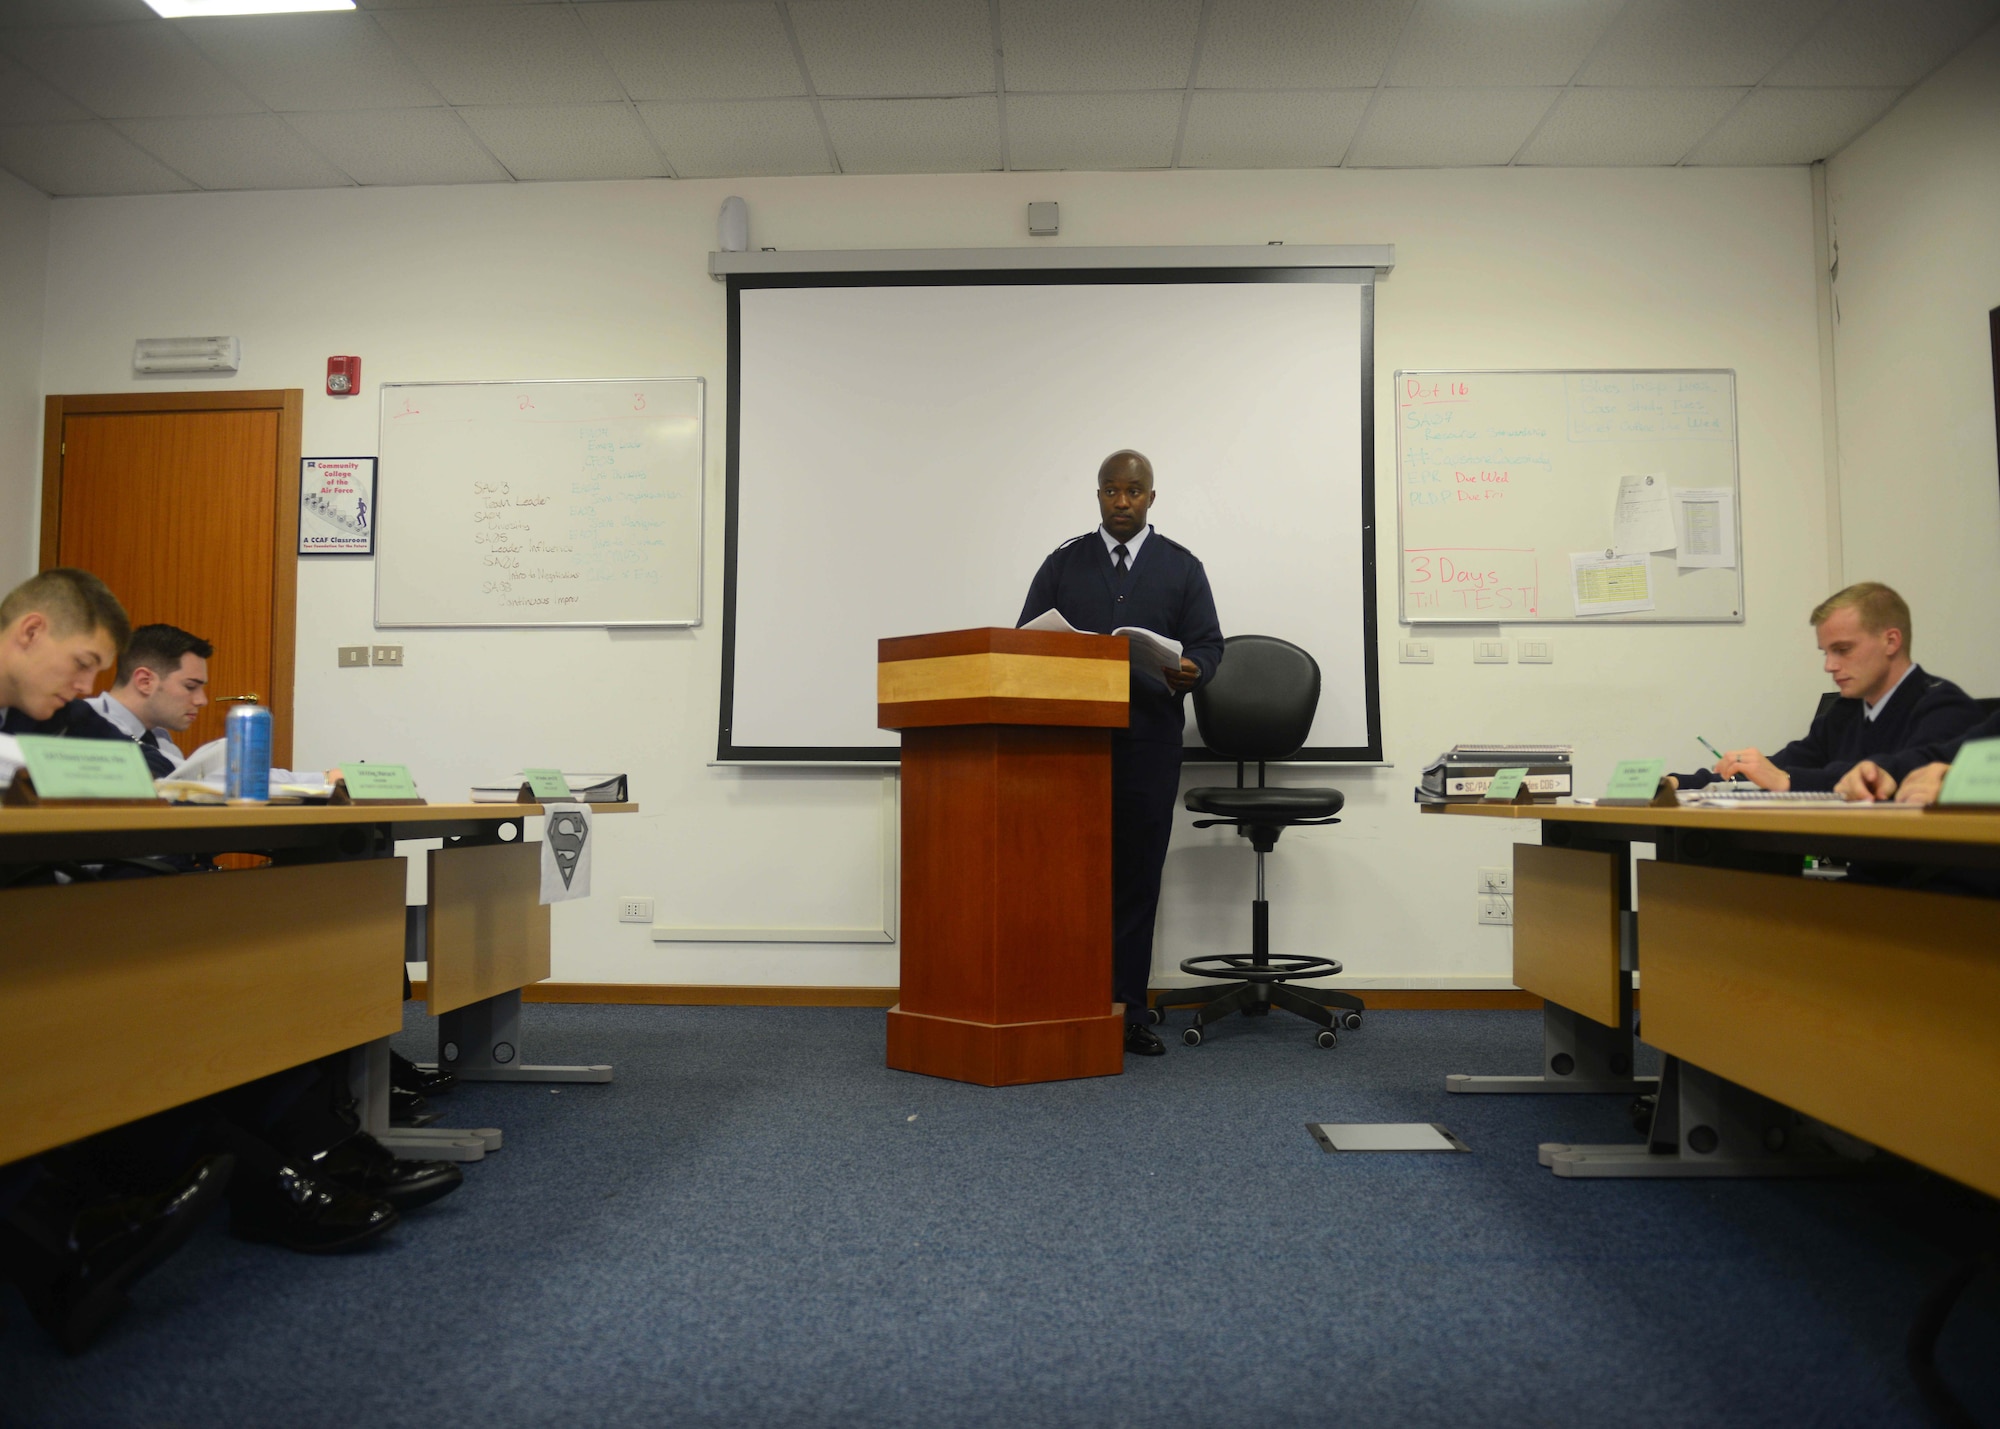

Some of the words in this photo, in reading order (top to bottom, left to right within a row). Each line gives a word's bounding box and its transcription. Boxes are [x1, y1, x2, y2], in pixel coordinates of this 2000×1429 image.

[517, 394, 535, 410] 2
[633, 393, 646, 411] 3
[1455, 471, 1478, 484] Due
[1481, 471, 1510, 484] Wed
[482, 497, 511, 509] Team
[515, 494, 551, 507] Leader
[1457, 489, 1480, 502] Due
[1484, 489, 1505, 500] Fri
[491, 543, 524, 553] Leader
[1409, 555, 1432, 583] 3
[1439, 556, 1499, 588] Days
[1408, 588, 1440, 608] Till
[1452, 587, 1536, 614] TEST!
